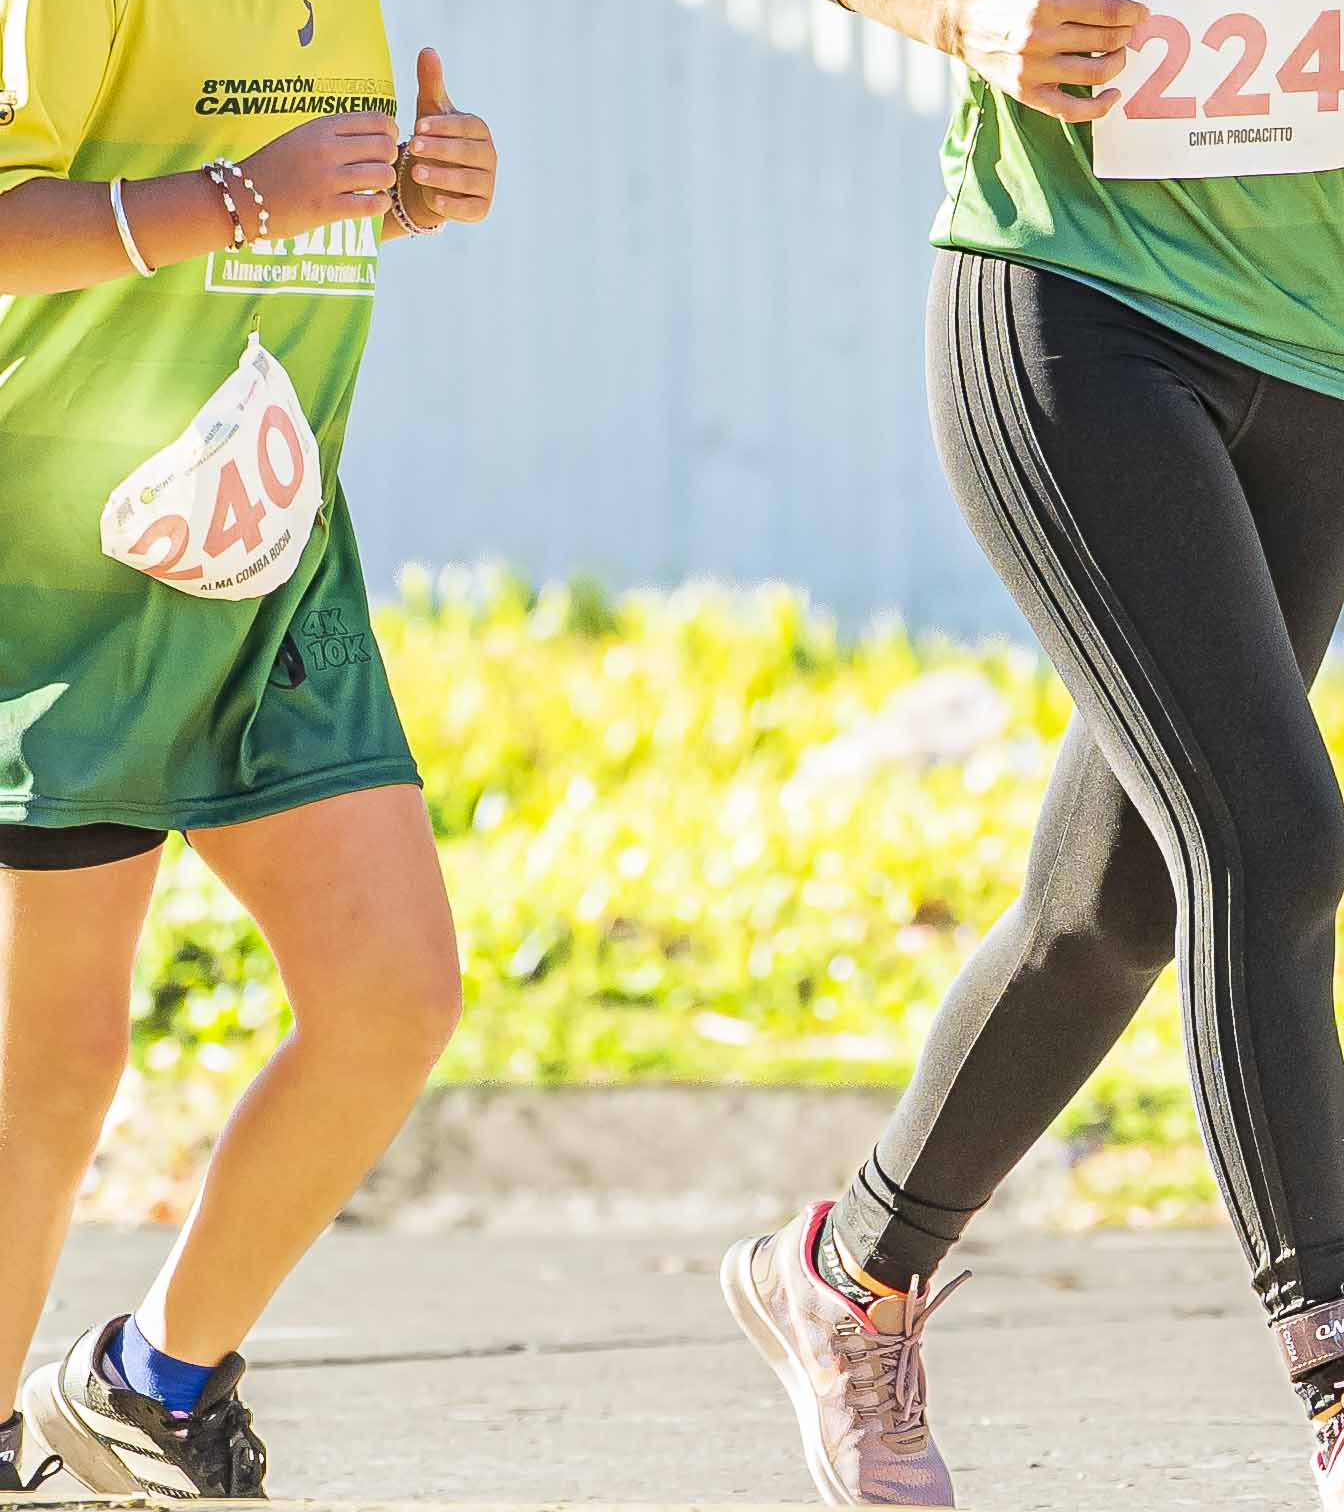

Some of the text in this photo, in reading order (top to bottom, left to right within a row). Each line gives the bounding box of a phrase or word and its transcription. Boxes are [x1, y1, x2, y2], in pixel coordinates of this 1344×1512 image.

[1189, 126, 1293, 147] CINTIA PROCACITTO
[127, 404, 305, 580] 240
[235, 554, 271, 584] COMBA
[269, 528, 292, 561] ROCHA
[302, 608, 348, 638] 4K
[307, 633, 371, 671] 10K
